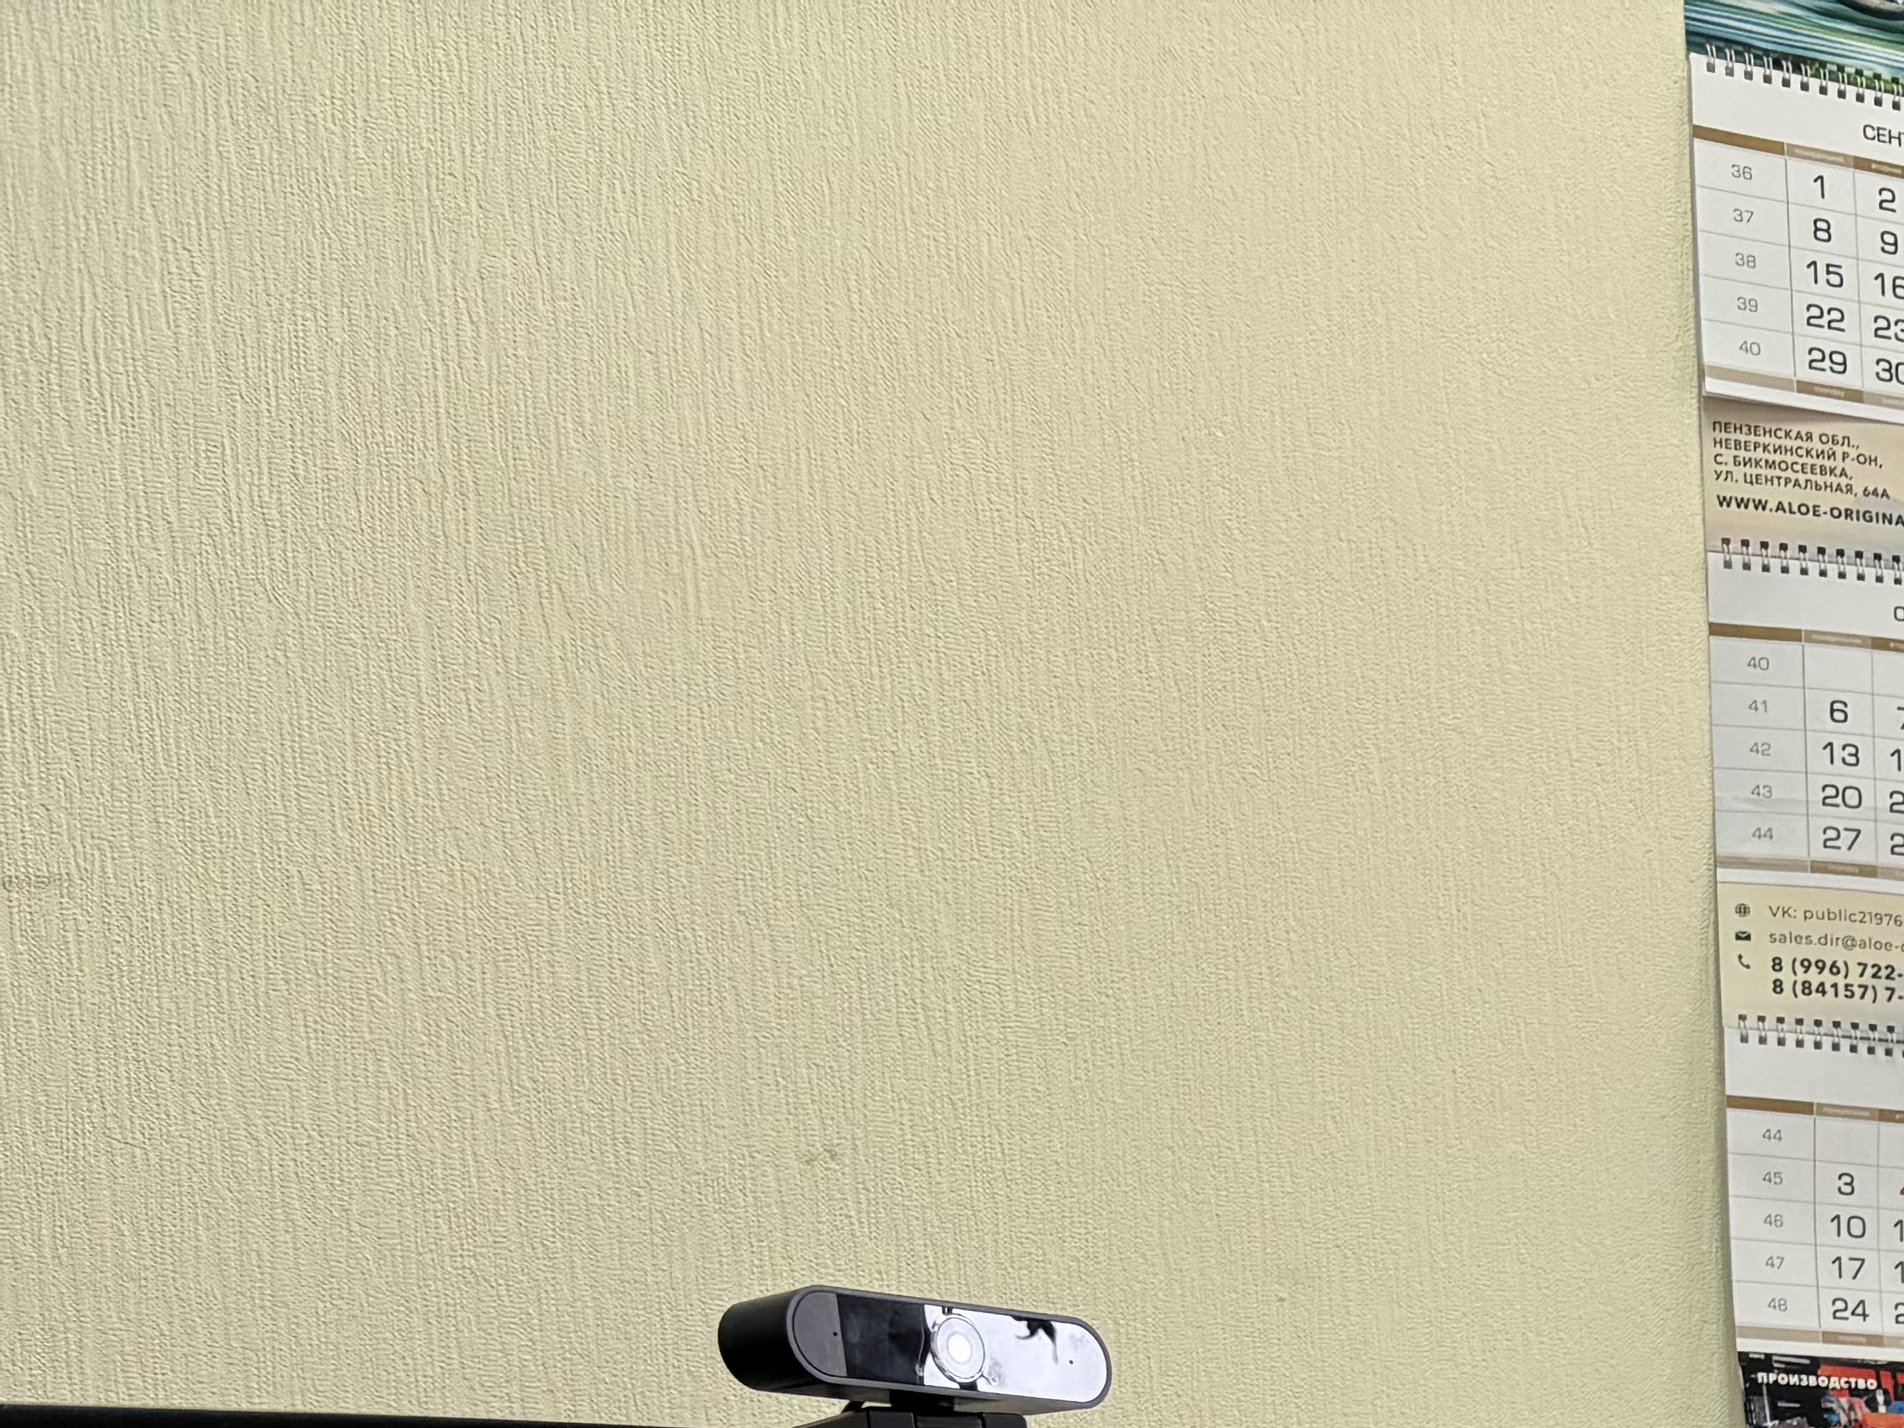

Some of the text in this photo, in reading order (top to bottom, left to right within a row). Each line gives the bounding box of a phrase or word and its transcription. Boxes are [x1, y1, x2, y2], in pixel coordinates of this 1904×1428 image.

[1813, 175, 1825, 199] 1
[1878, 187, 1896, 213] 2
[1806, 303, 1845, 332] 22
[1711, 420, 1815, 446] ПЕНЗЕНСКАЯ
[1712, 438, 1837, 462] НЕВЕРКИНСКИЙ
[1732, 454, 1854, 481] БИКМОСЕЕВКА,
[1713, 470, 1739, 486] УЛ.
[1742, 471, 1857, 498] ЦЕНТРАЛЬНАЯ,
[1823, 826, 1861, 851] 27
[1768, 904, 1799, 921] VK:
[1771, 956, 1784, 974] 8
[1791, 956, 1850, 982] (996)
[1772, 978, 1785, 995] 8
[1791, 979, 1878, 1005] (84157)
[1837, 1173, 1855, 1196] 3
[1757, 1370, 1879, 1392] ПРОИЗВОДСТВО
